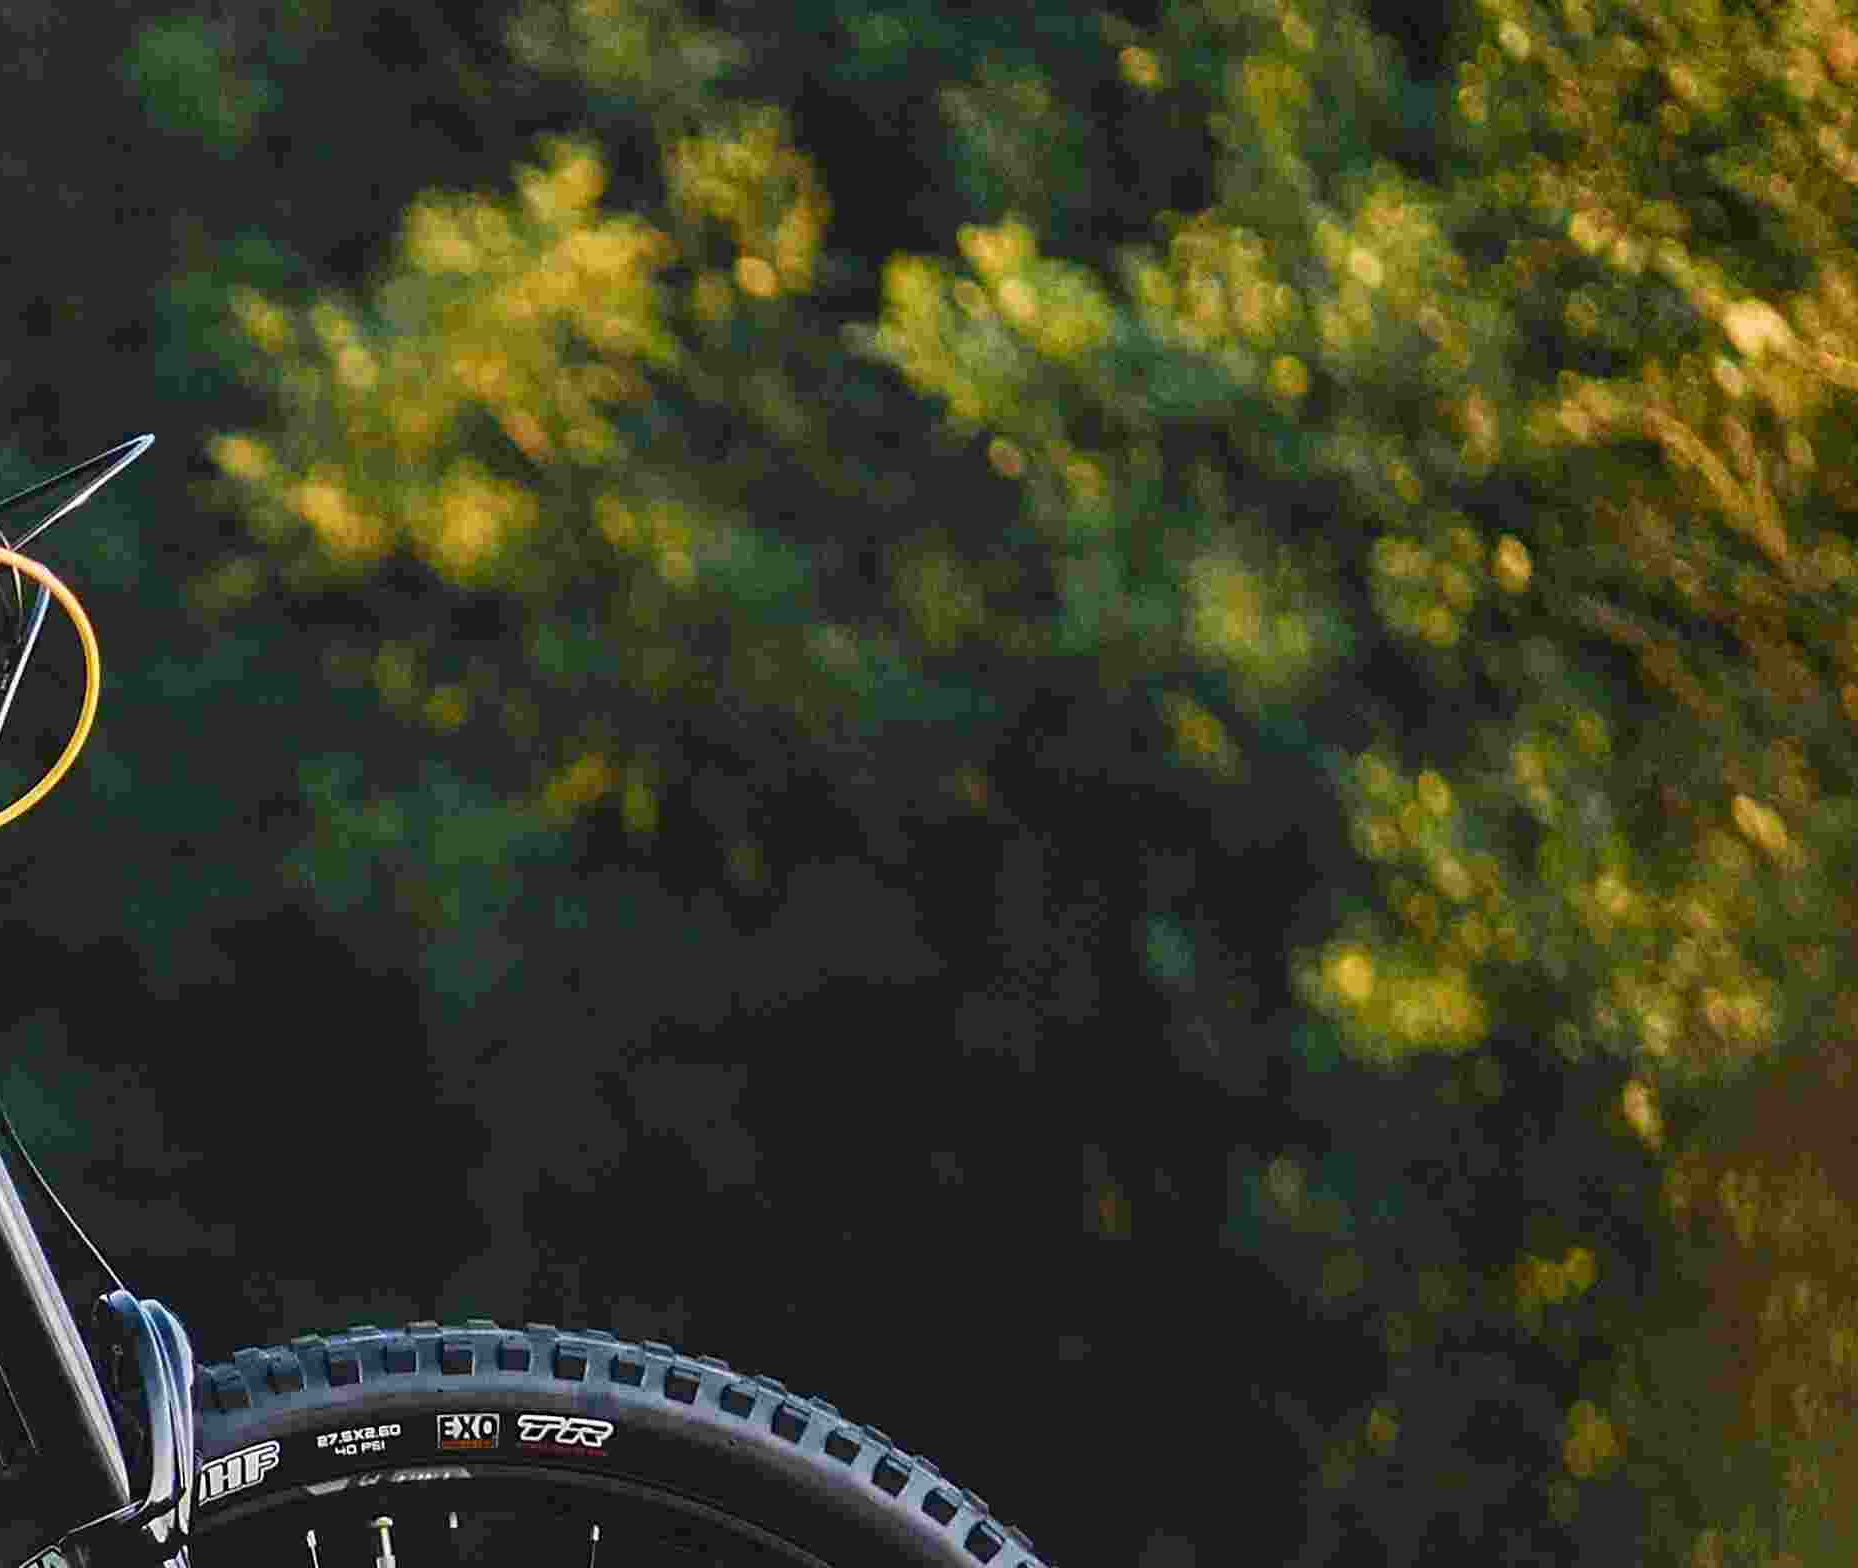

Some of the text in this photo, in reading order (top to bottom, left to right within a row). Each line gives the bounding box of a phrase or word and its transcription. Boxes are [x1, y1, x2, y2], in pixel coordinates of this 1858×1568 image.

[316, 1423, 402, 1449] 27.5X2.60
[440, 1413, 499, 1443] EXO
[517, 1414, 614, 1448] TR
[335, 1439, 386, 1457] 40 PSI
